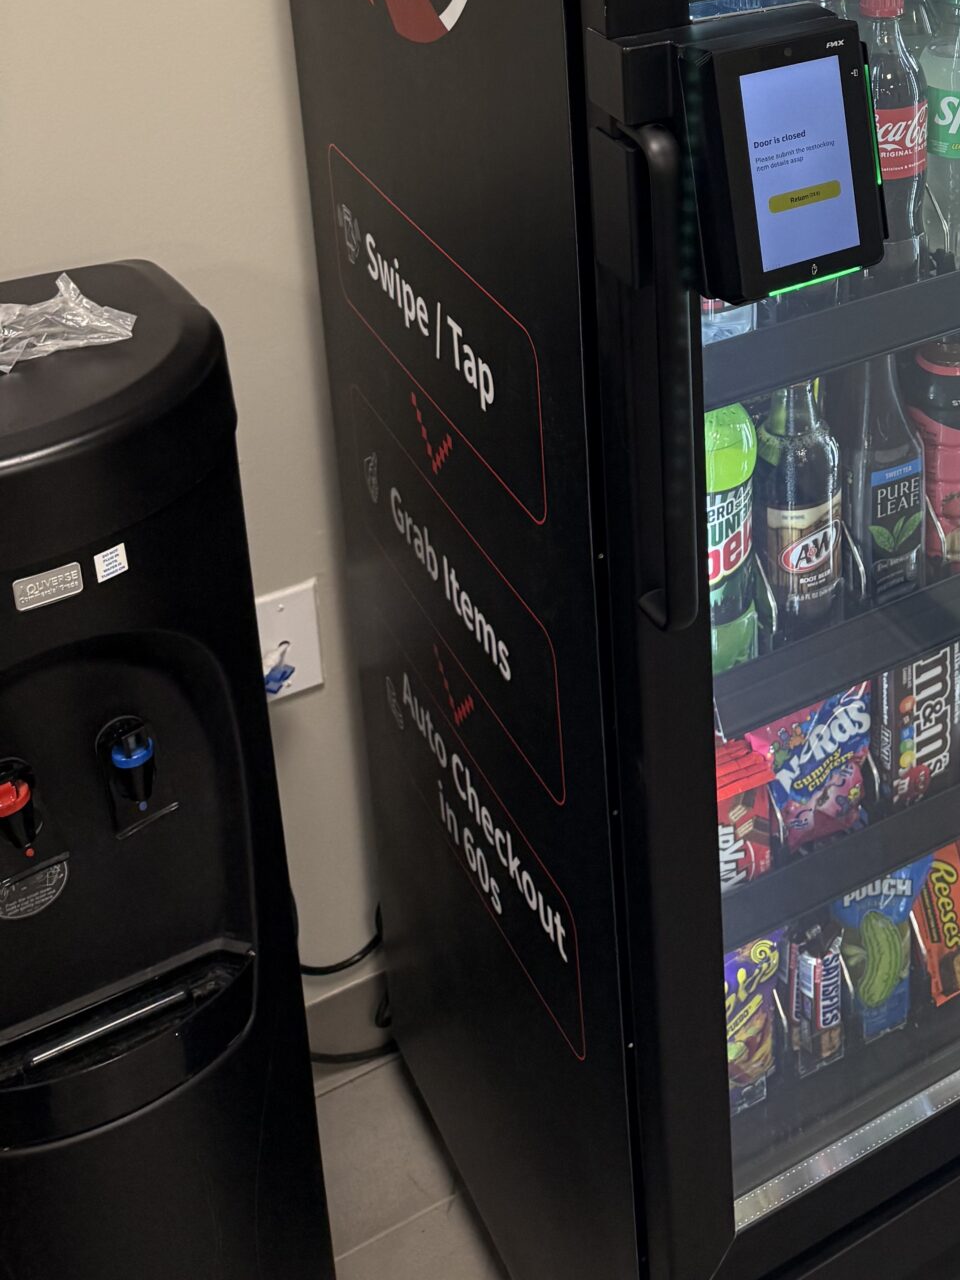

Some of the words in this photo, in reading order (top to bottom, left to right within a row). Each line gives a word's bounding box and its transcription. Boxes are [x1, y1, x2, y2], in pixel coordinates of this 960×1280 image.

[826, 39, 845, 49] PAX
[753, 140, 772, 149] Door
[774, 136, 780, 145] is
[781, 130, 806, 142] closed
[880, 148, 912, 158] RIGINAL
[755, 154, 775, 163] Please
[796, 146, 805, 154] the
[365, 233, 429, 336] Swipe
[436, 302, 441, 359] /
[447, 315, 495, 412] Tap
[877, 477, 920, 503] PURE
[877, 491, 918, 518] LEAF
[20, 569, 79, 596] QUVERSE
[391, 487, 440, 568] Grab
[443, 555, 511, 681] Items
[402, 673, 447, 769] Auto
[452, 753, 568, 963] Checkout
[437, 780, 461, 846] in
[463, 826, 502, 916] 60s
[843, 878, 912, 907] POUCH
[820, 954, 841, 1028] SATISFIES
